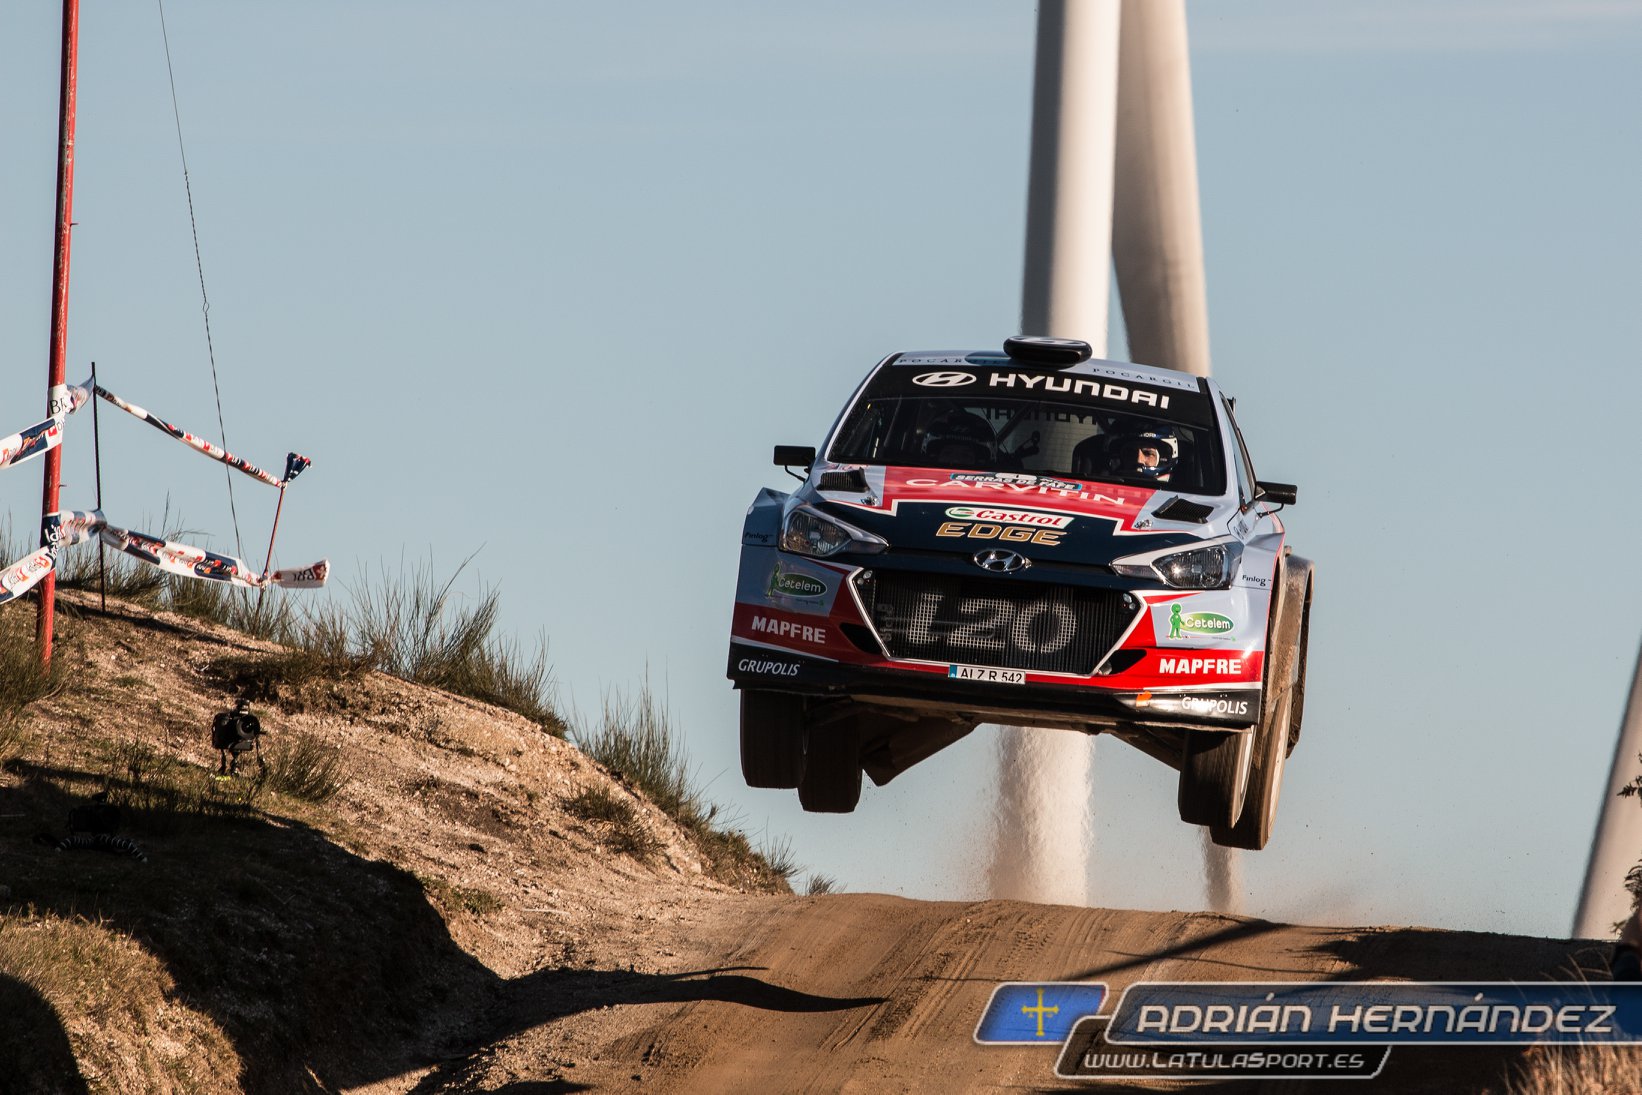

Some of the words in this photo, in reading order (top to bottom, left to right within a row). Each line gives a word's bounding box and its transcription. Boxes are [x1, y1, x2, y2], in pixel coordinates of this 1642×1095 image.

[988, 372, 1170, 410] HYUNDAI
[904, 477, 1125, 505] CARVITIN
[976, 510, 1061, 526] Castrol
[935, 521, 1068, 547] EDGE
[778, 577, 821, 593] Cetelem
[1241, 574, 1267, 587] Finlog
[751, 615, 826, 644] MAPFRE
[1184, 616, 1231, 630] Cetelem
[738, 658, 800, 677] GRUPOLIS
[1159, 658, 1242, 675] MAPFRE
[1181, 696, 1248, 715] GRUPOLIS
